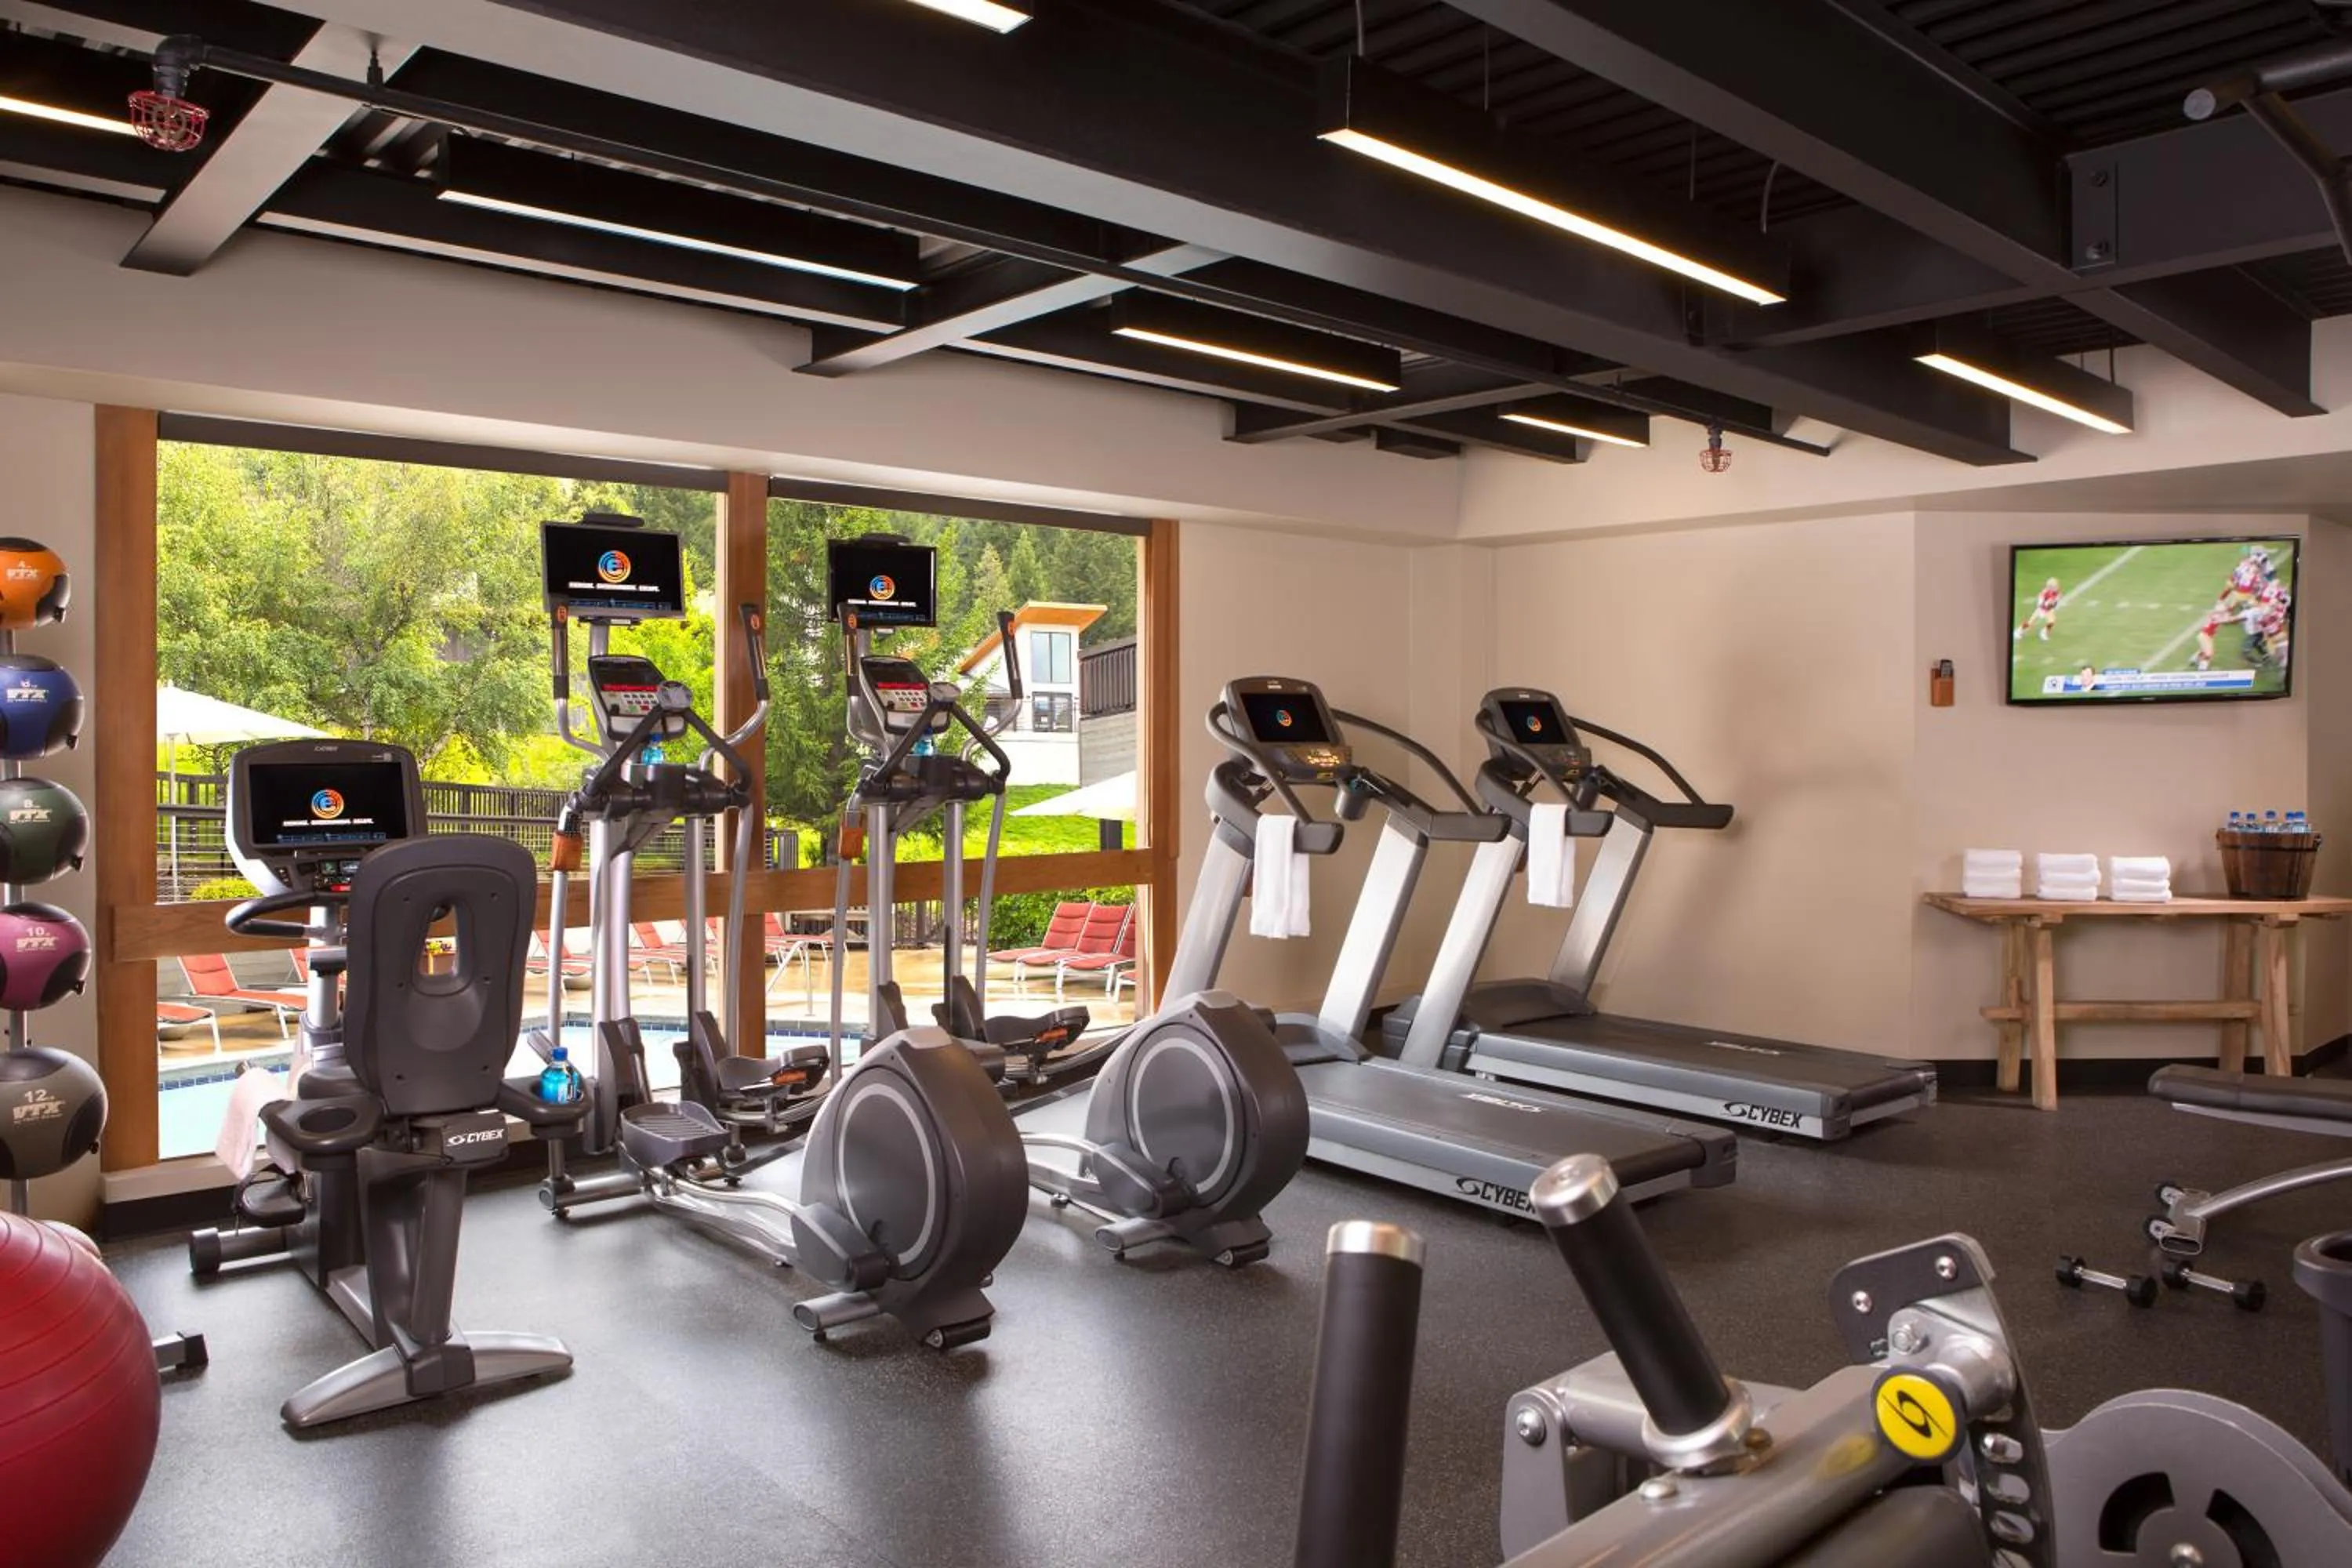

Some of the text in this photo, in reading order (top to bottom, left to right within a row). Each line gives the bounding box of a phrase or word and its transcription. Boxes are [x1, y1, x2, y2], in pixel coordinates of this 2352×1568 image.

[27, 926, 45, 936] 10
[24, 1089, 47, 1103] 12
[1747, 1104, 1802, 1129] CYBEX
[466, 1129, 504, 1143] CYBEX
